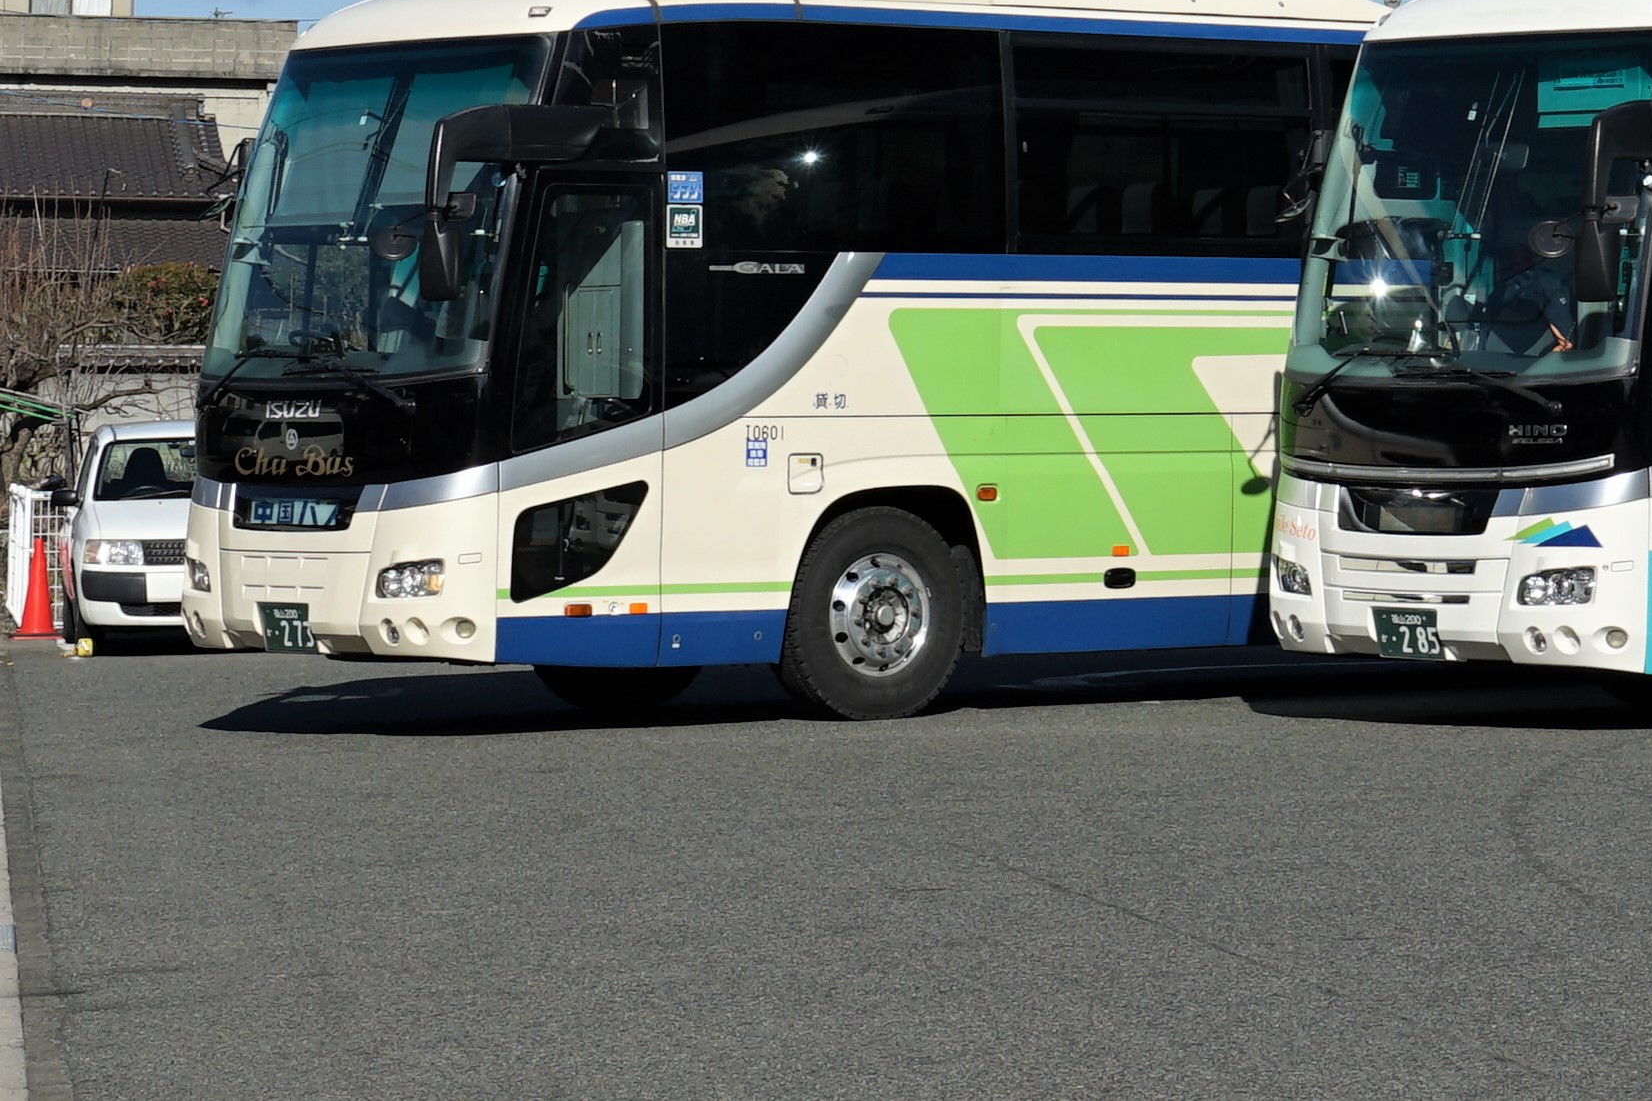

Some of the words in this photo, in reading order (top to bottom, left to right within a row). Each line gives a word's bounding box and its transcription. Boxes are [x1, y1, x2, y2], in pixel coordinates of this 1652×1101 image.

[673, 213, 696, 226] NBA
[733, 261, 805, 274] GALA
[265, 400, 321, 418] ISUZU
[815, 393, 847, 409] 貸切
[1509, 424, 1567, 436] HINO
[295, 444, 354, 477] Bus
[1399, 625, 1441, 655] 285
